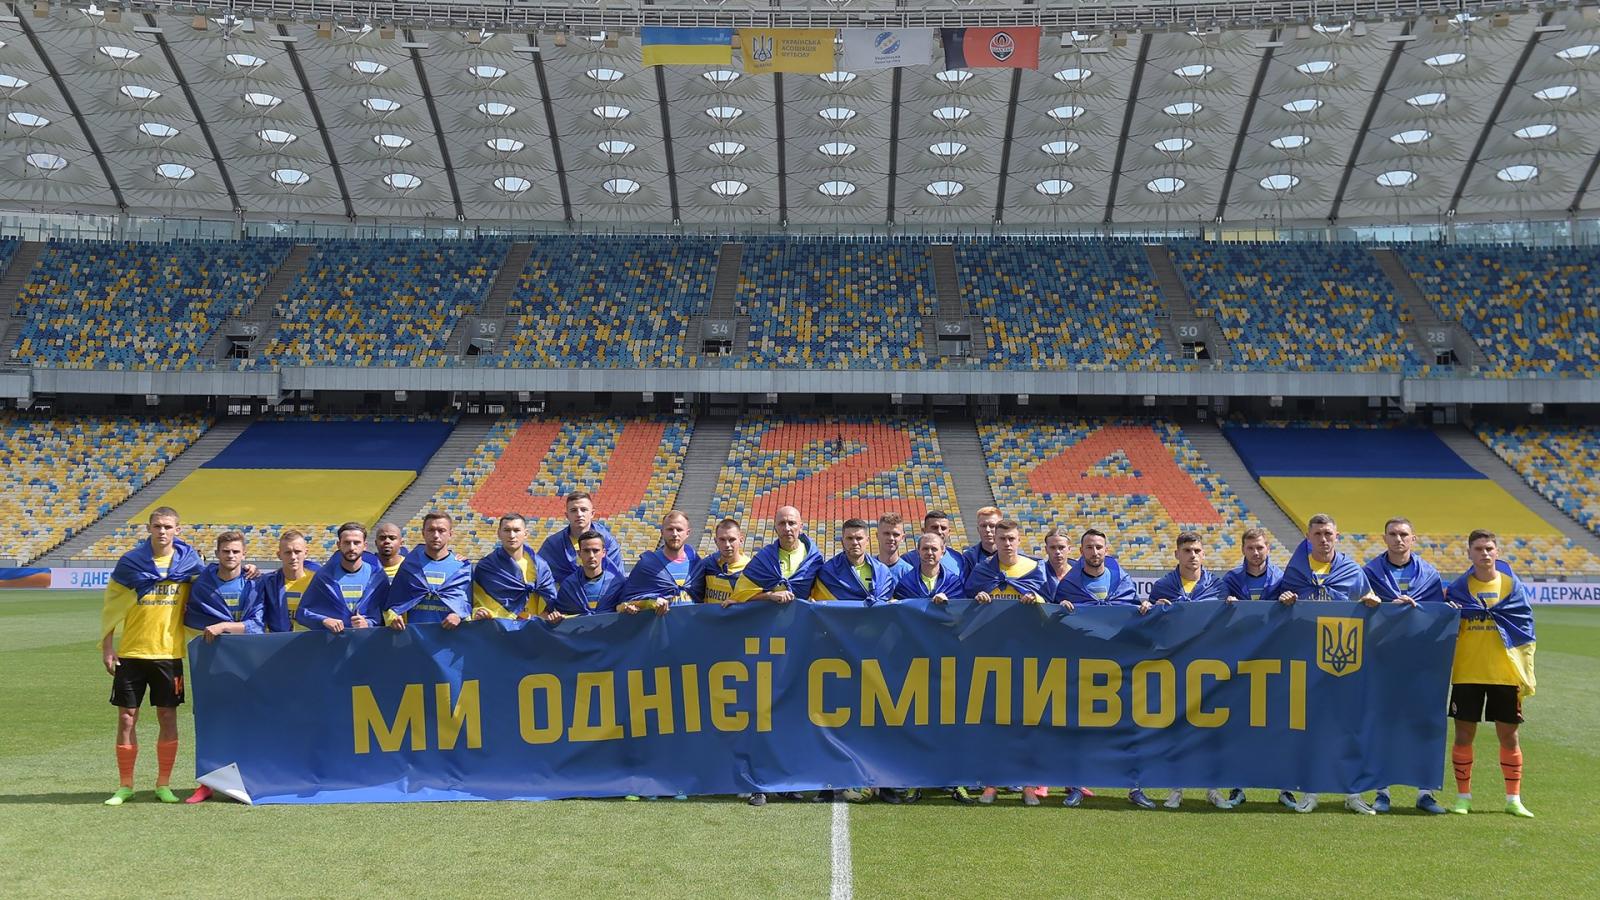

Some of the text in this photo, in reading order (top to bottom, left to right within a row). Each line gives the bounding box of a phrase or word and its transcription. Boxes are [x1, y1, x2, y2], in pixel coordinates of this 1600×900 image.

[479, 323, 496, 333] 36
[711, 324, 728, 335] 34
[1180, 326, 1198, 337] 30
[1427, 331, 1446, 343] 28
[81, 572, 112, 587] ДНЕ
[351, 637, 1307, 754] МИ ОДНІЄЇ СМІЛИВОСТІ
